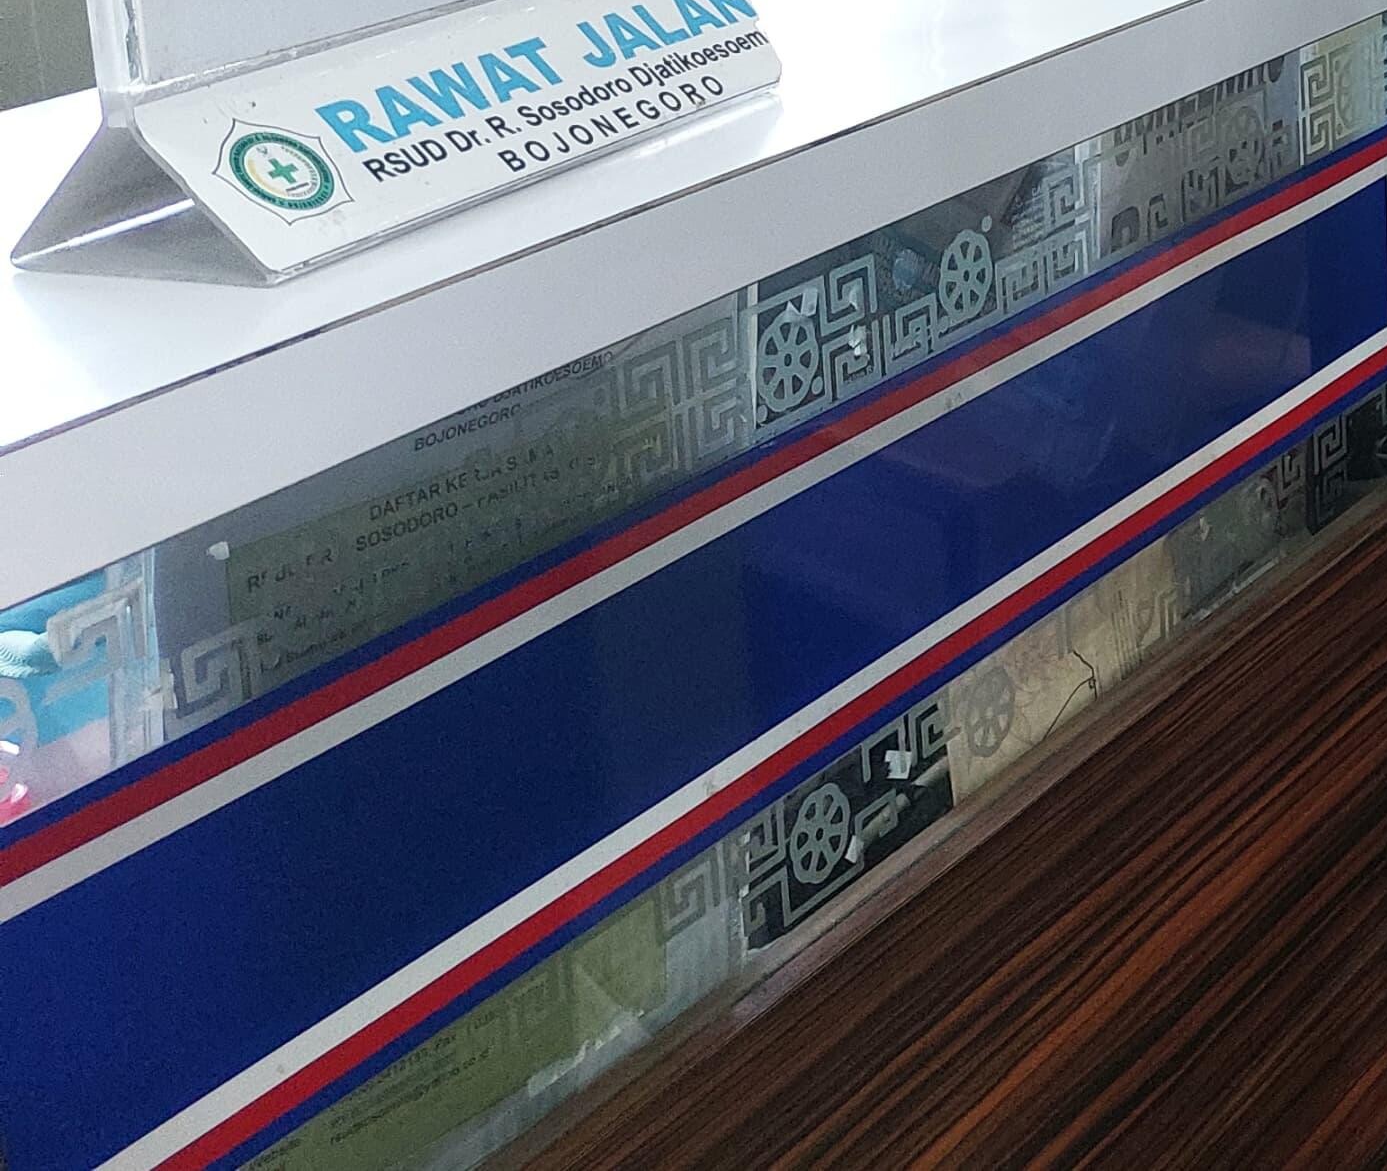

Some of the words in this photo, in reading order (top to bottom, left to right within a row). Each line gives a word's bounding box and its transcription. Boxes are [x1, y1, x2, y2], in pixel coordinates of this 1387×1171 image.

[315, 36, 563, 153] RAWAT
[362, 139, 448, 183] RSUD
[455, 127, 491, 154] Dr.
[486, 115, 522, 139] R.
[517, 75, 633, 127] Sosodoro
[497, 75, 724, 173] BOJONEGORO
[355, 503, 458, 553] SOSODORO
[368, 485, 441, 522] DAFTAR
